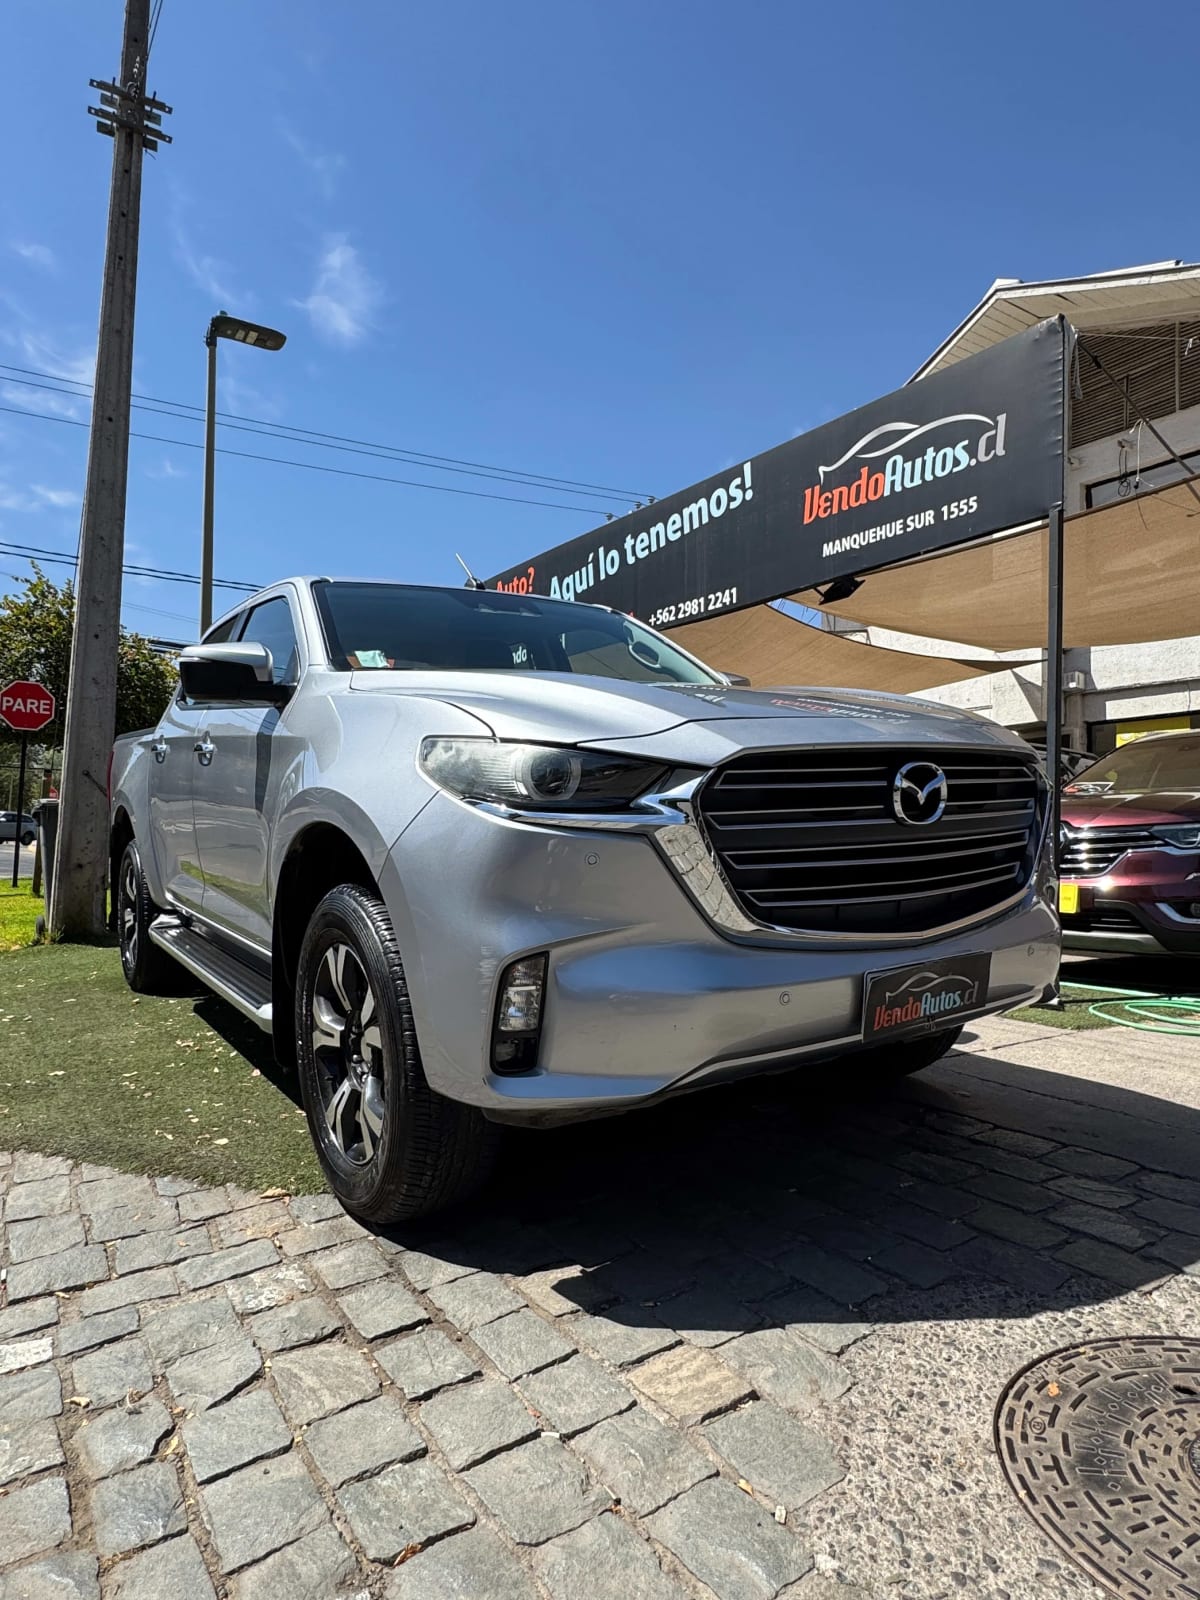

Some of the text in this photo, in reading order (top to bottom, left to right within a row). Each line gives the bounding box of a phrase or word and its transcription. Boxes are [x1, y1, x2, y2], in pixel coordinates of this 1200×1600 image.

[802, 412, 1007, 526] VendoAutos.cl
[549, 552, 595, 602] Aquí
[598, 545, 620, 581] lo
[623, 461, 754, 566] tenemos!
[822, 495, 978, 558] MANQUEHUE SUR 1555
[648, 586, 738, 627] +562 2981 2241
[1, 696, 51, 715] PARE
[873, 980, 979, 1031] VendoAutos.cl
